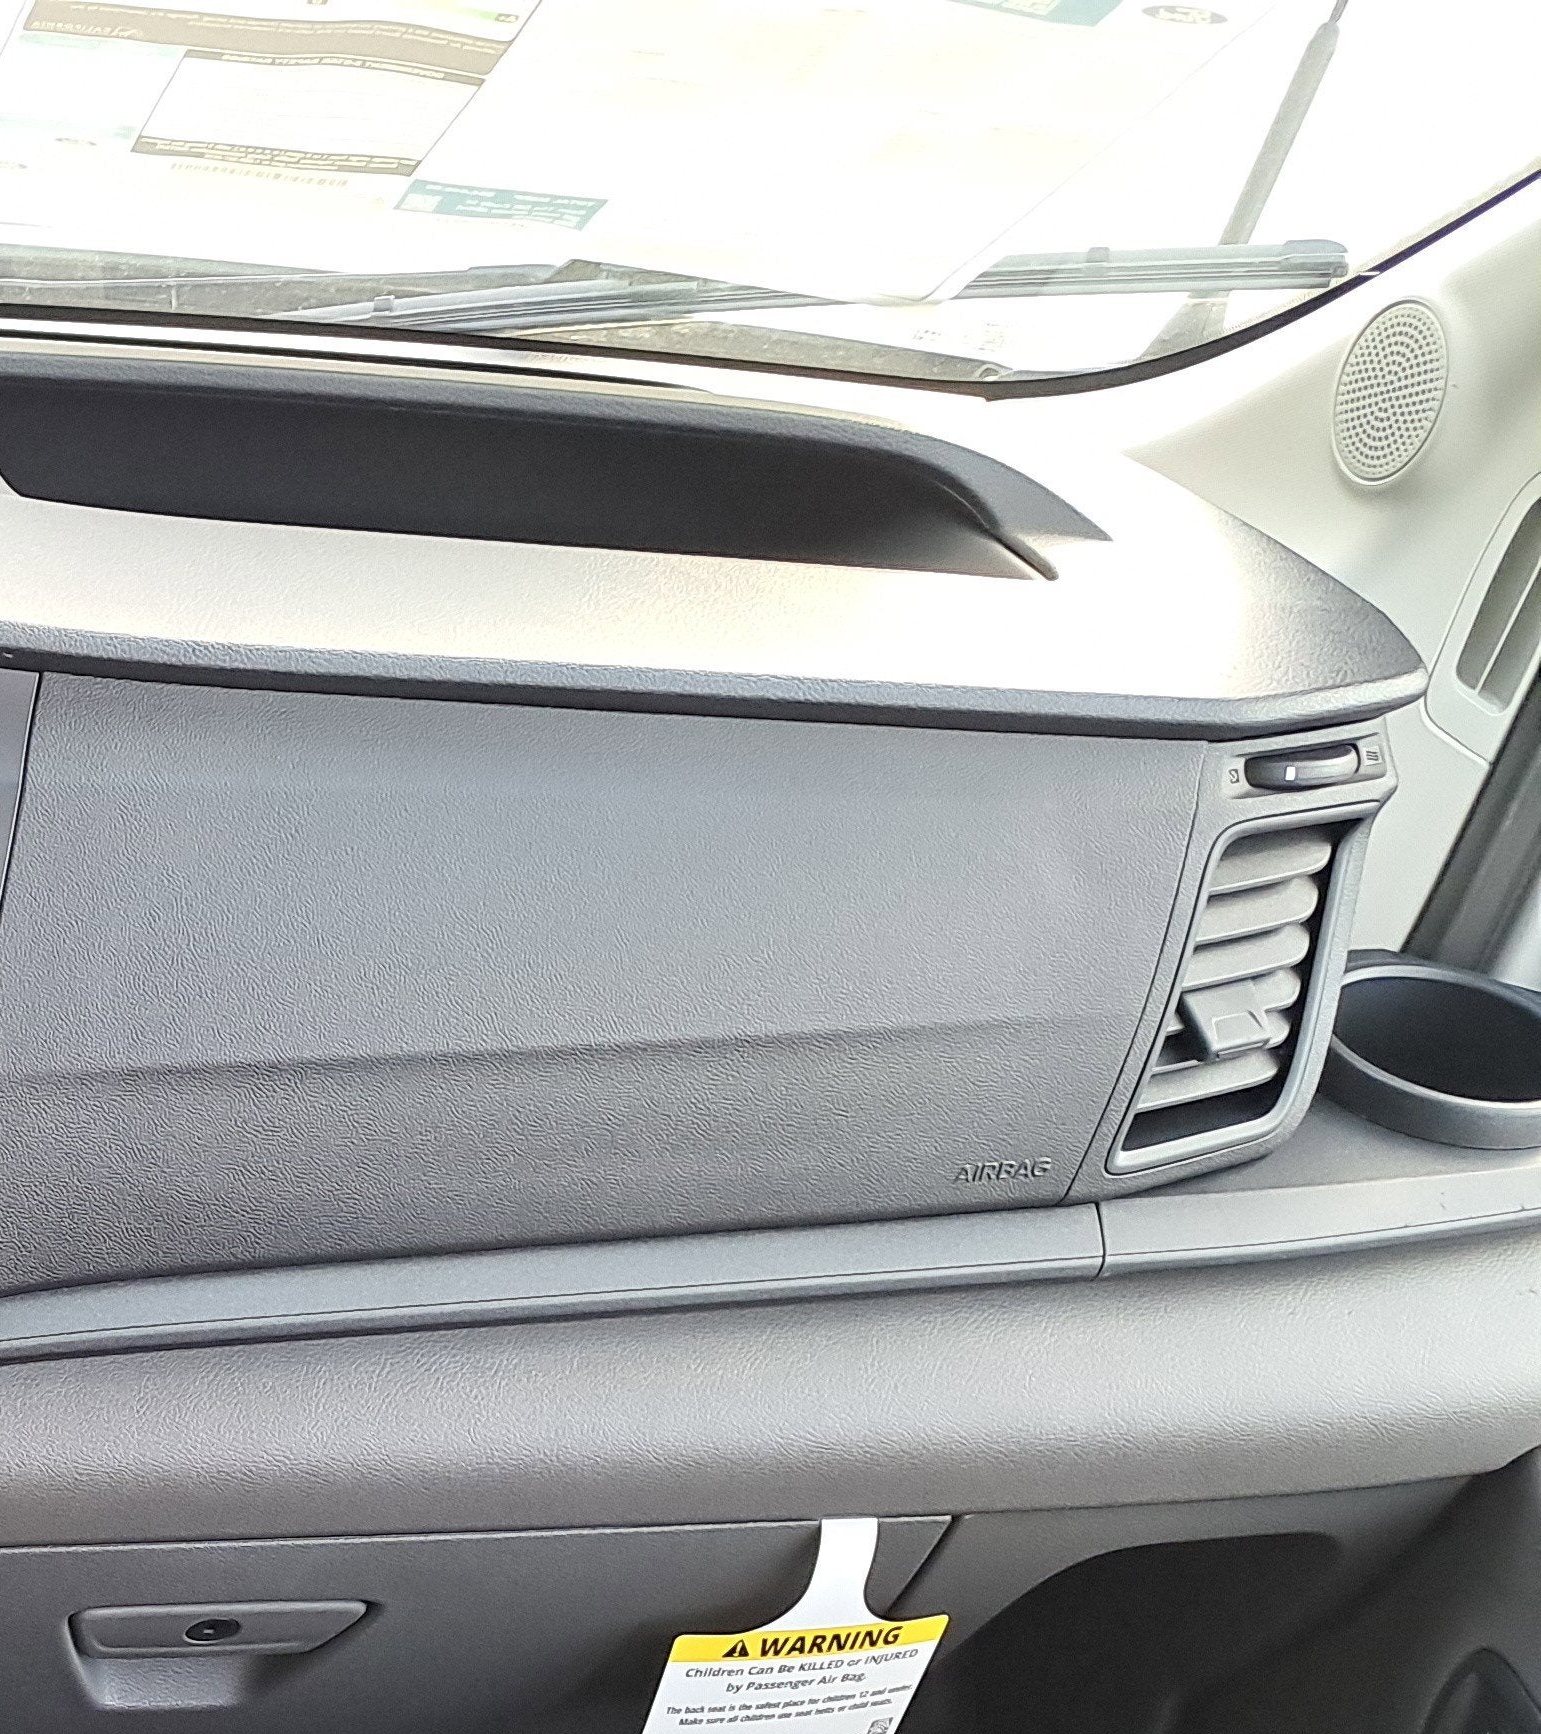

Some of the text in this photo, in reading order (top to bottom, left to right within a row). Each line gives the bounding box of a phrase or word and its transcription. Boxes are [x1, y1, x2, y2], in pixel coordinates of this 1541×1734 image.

[953, 1155, 1053, 1183] AIRBAG
[760, 1625, 904, 1658] WARNING
[685, 1666, 745, 1678] Children
[747, 1665, 774, 1676] Can
[777, 1664, 795, 1674] Be
[798, 1659, 844, 1672] KILLED
[864, 1648, 919, 1665] INJURED
[725, 1682, 743, 1694] by
[745, 1678, 817, 1692] Passenger
[816, 1675, 838, 1685] Air
[666, 1706, 682, 1715] The
[684, 1705, 705, 1714] back
[728, 1703, 736, 1712] is
[738, 1702, 753, 1712] the
